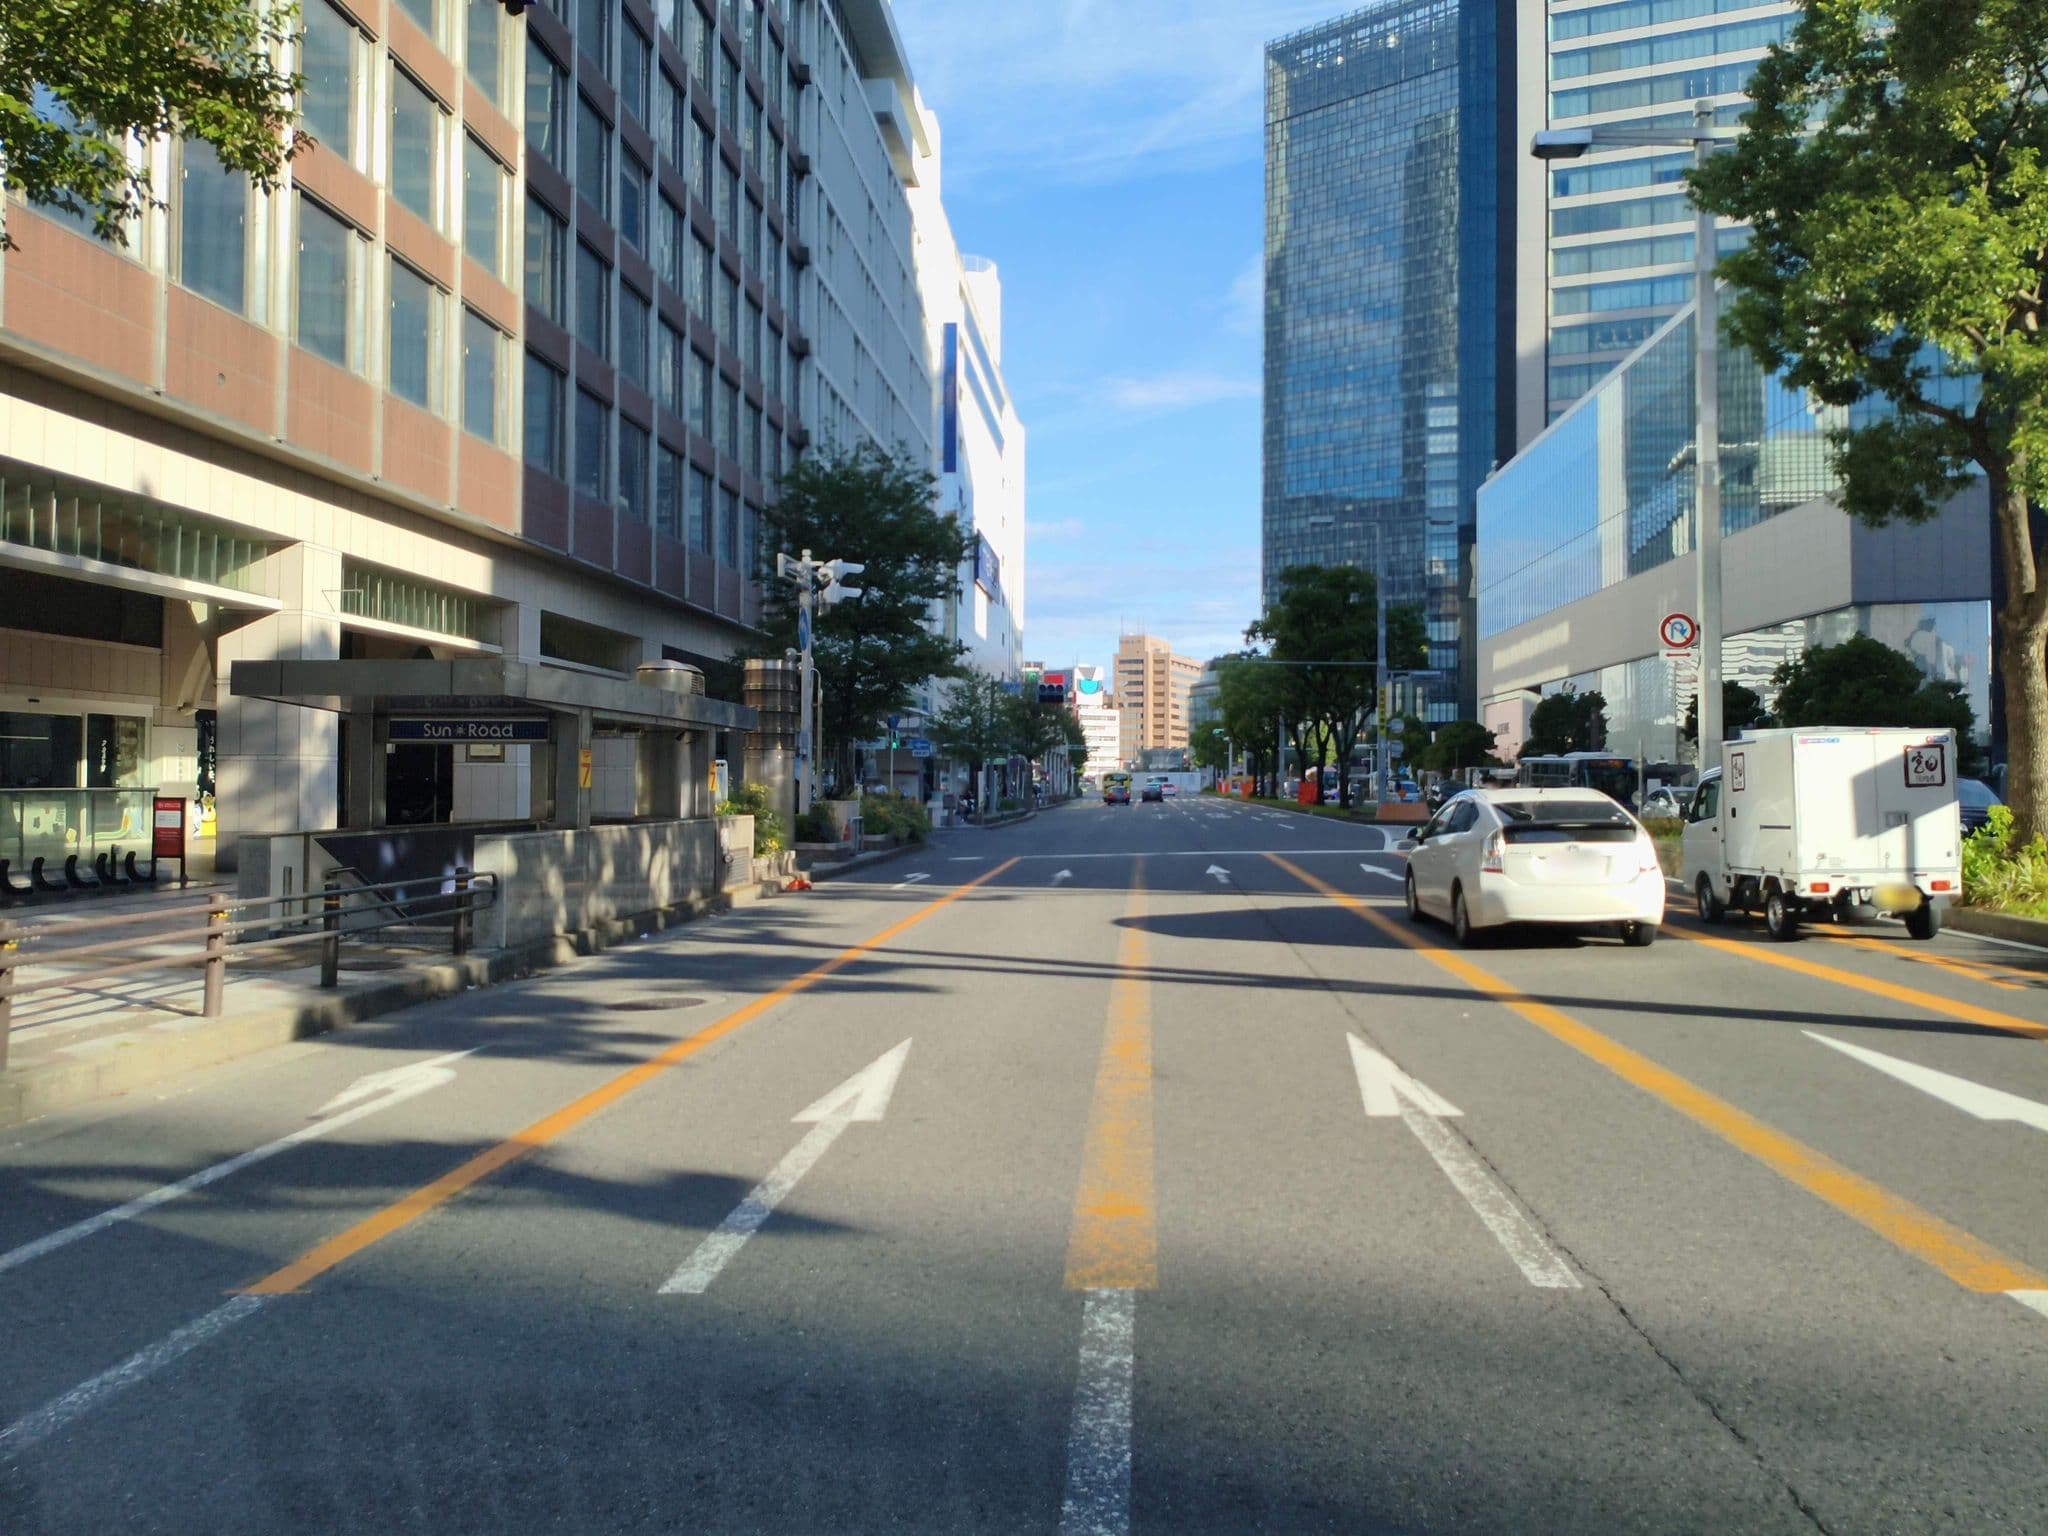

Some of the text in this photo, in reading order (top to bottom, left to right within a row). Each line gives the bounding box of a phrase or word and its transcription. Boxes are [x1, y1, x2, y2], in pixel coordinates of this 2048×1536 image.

[424, 723, 514, 738] Sun Road
[582, 763, 591, 785] 7
